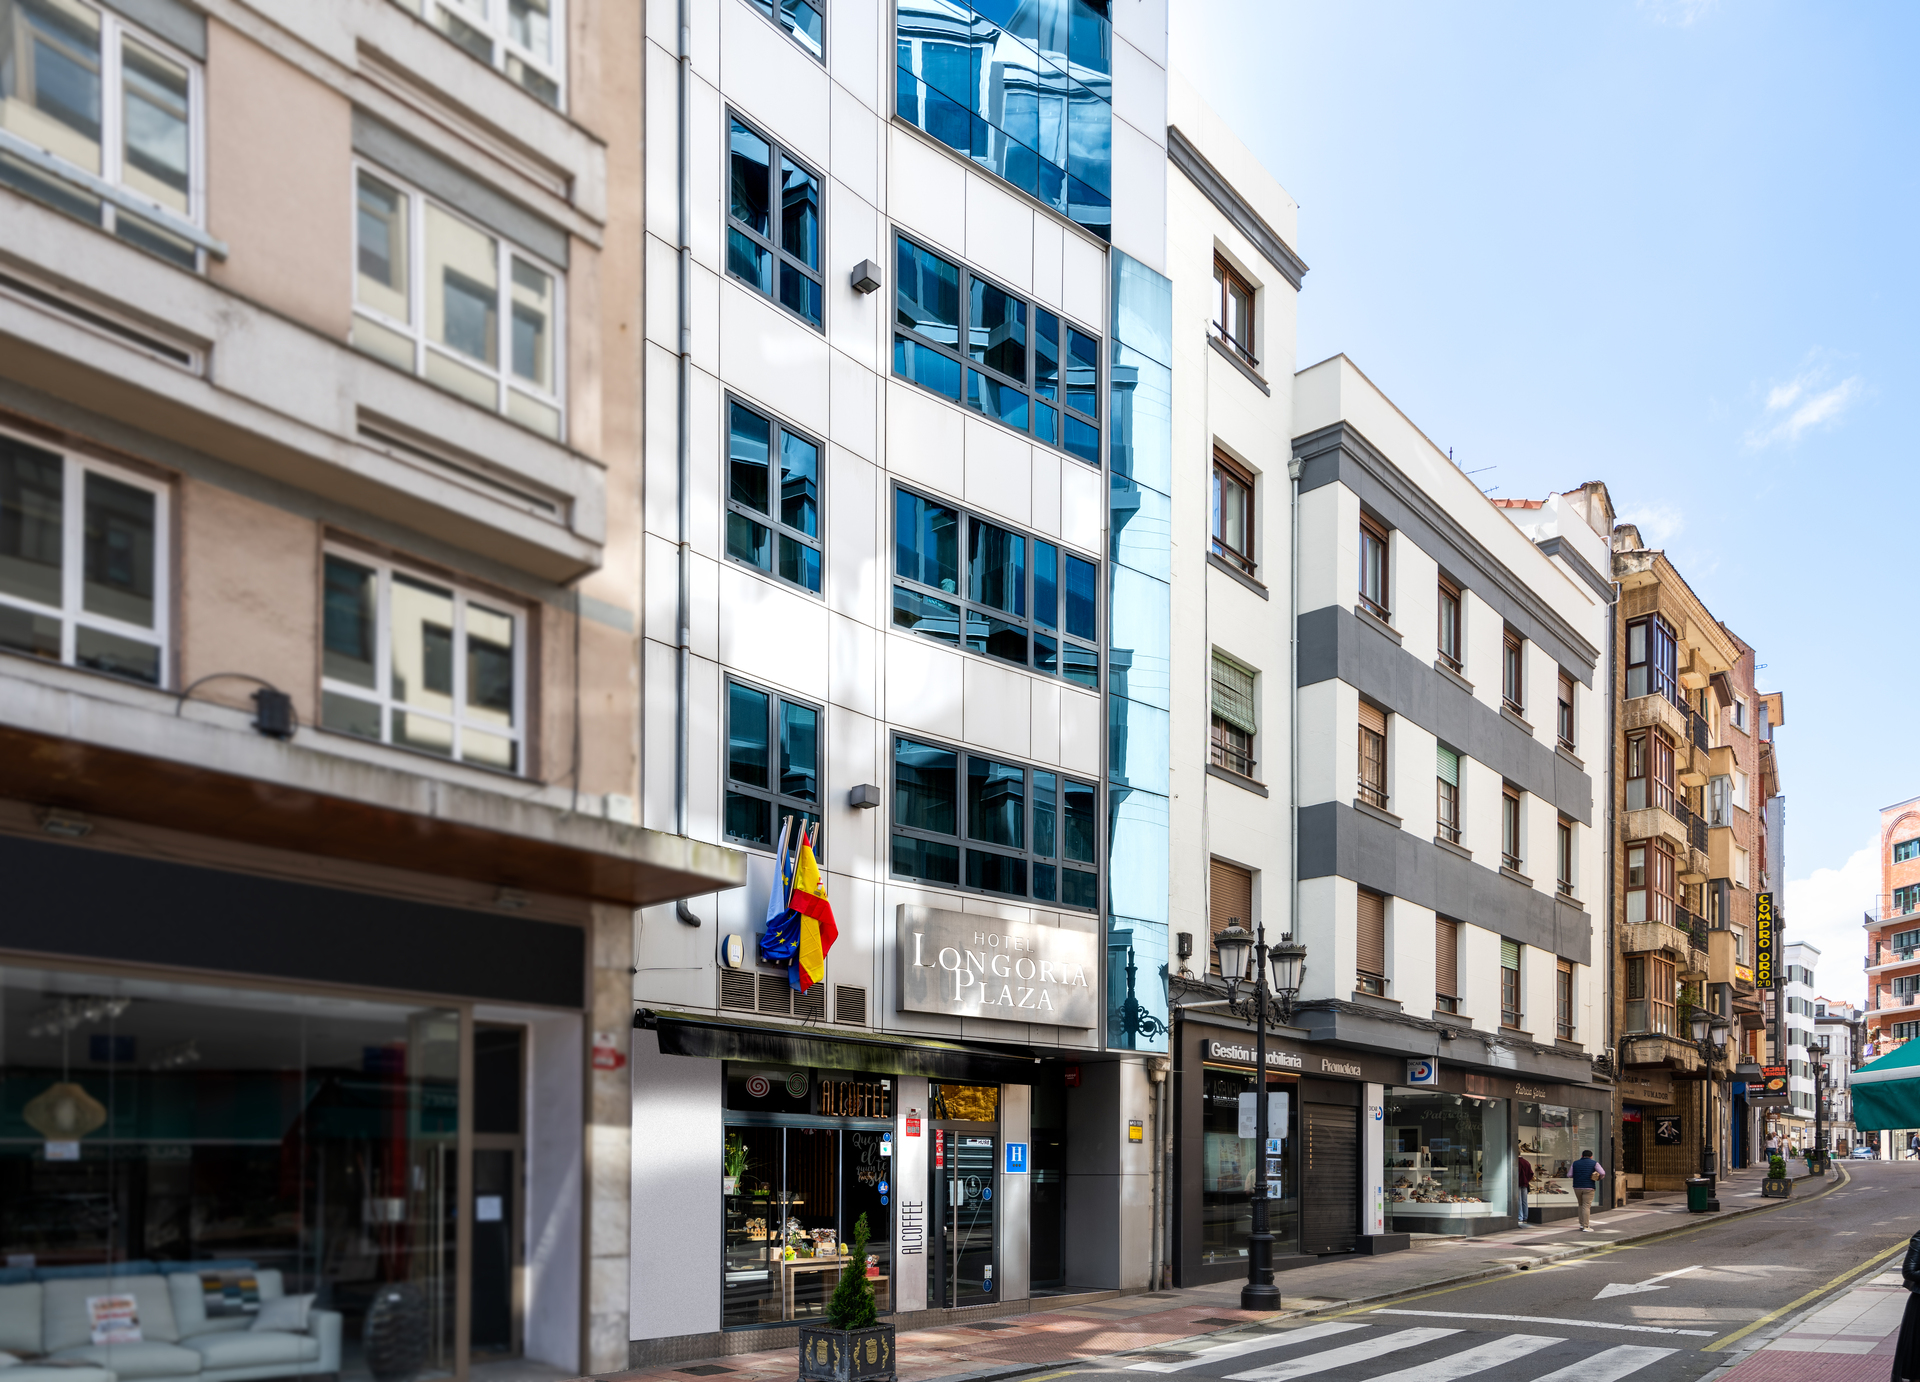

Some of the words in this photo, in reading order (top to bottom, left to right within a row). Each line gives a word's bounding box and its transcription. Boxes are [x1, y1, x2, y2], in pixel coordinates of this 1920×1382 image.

[1757, 894, 1771, 948] COMPRO
[974, 931, 1034, 953] HOTEL
[912, 932, 1089, 987] LONGORIA
[1758, 952, 1771, 980] ORO
[953, 968, 1054, 1011] PLAZA
[1211, 1042, 1249, 1061] Gestión
[1251, 1048, 1302, 1068] inobiliaria
[1321, 1058, 1361, 1076] Promotora
[1643, 1089, 1669, 1100] FUMADOR
[1011, 1146, 1022, 1161] H
[902, 1201, 922, 1255] ALCOFFEE
